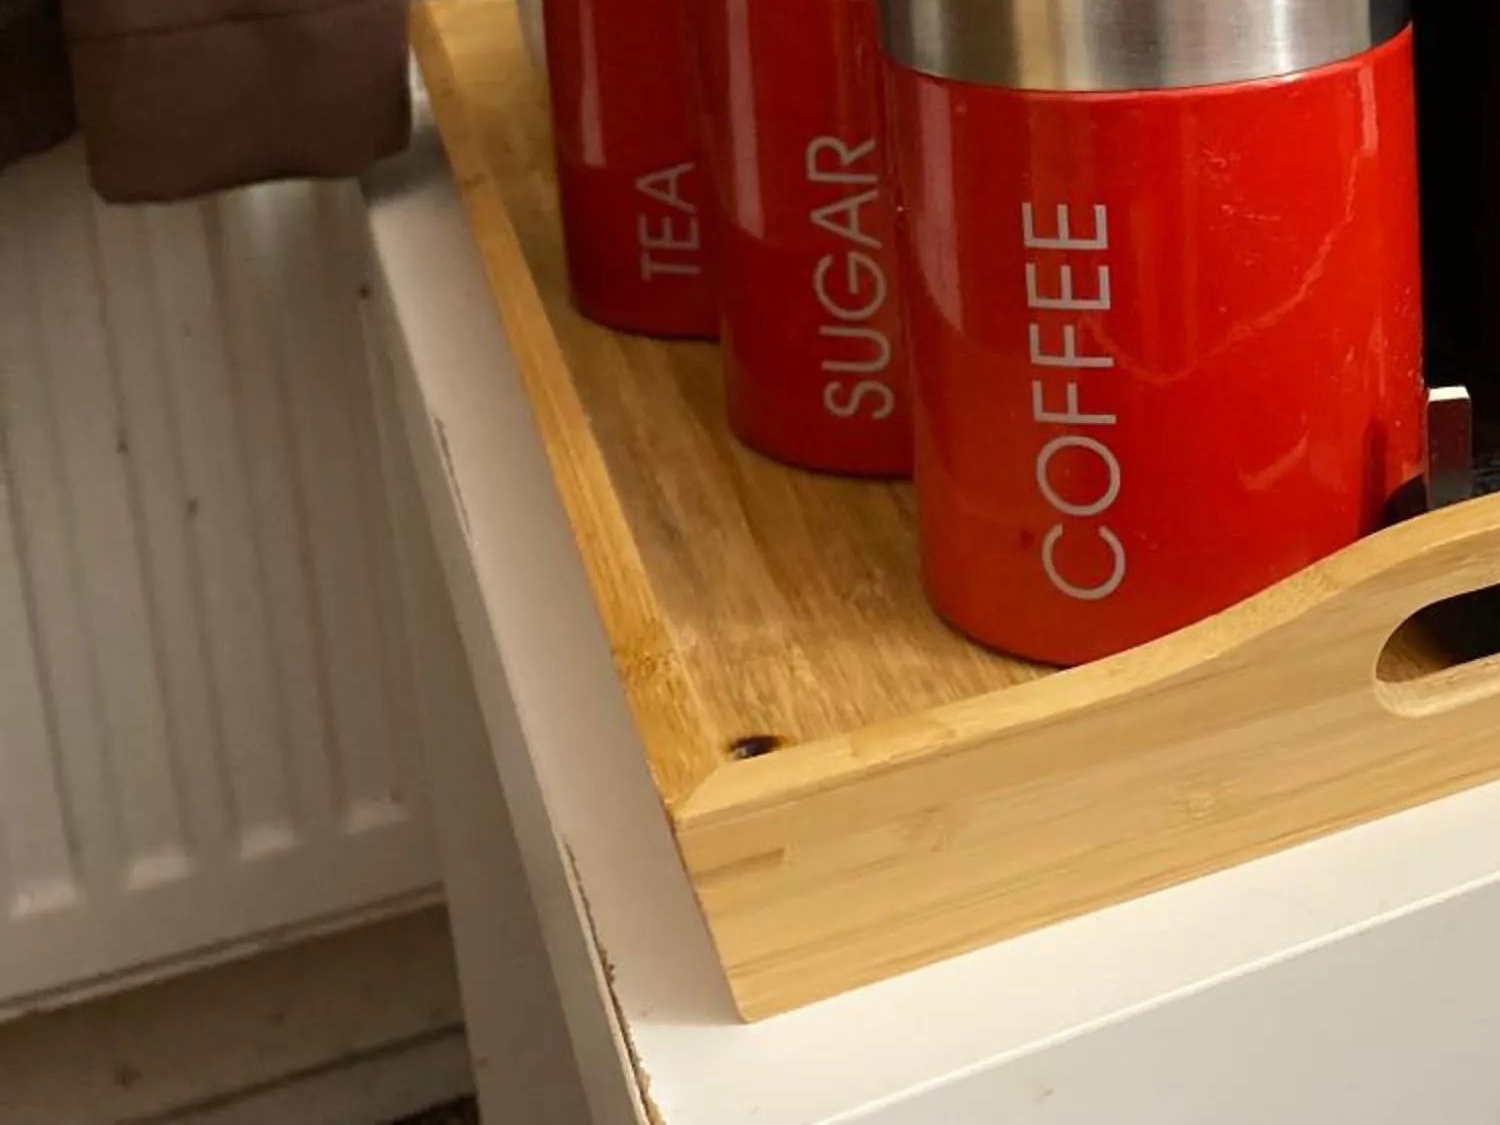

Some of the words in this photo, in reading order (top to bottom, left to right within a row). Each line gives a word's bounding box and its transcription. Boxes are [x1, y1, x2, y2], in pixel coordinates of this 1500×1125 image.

[636, 163, 702, 280] TEA
[807, 136, 894, 420] SUGAR
[1023, 202, 1126, 600] COFFEE
